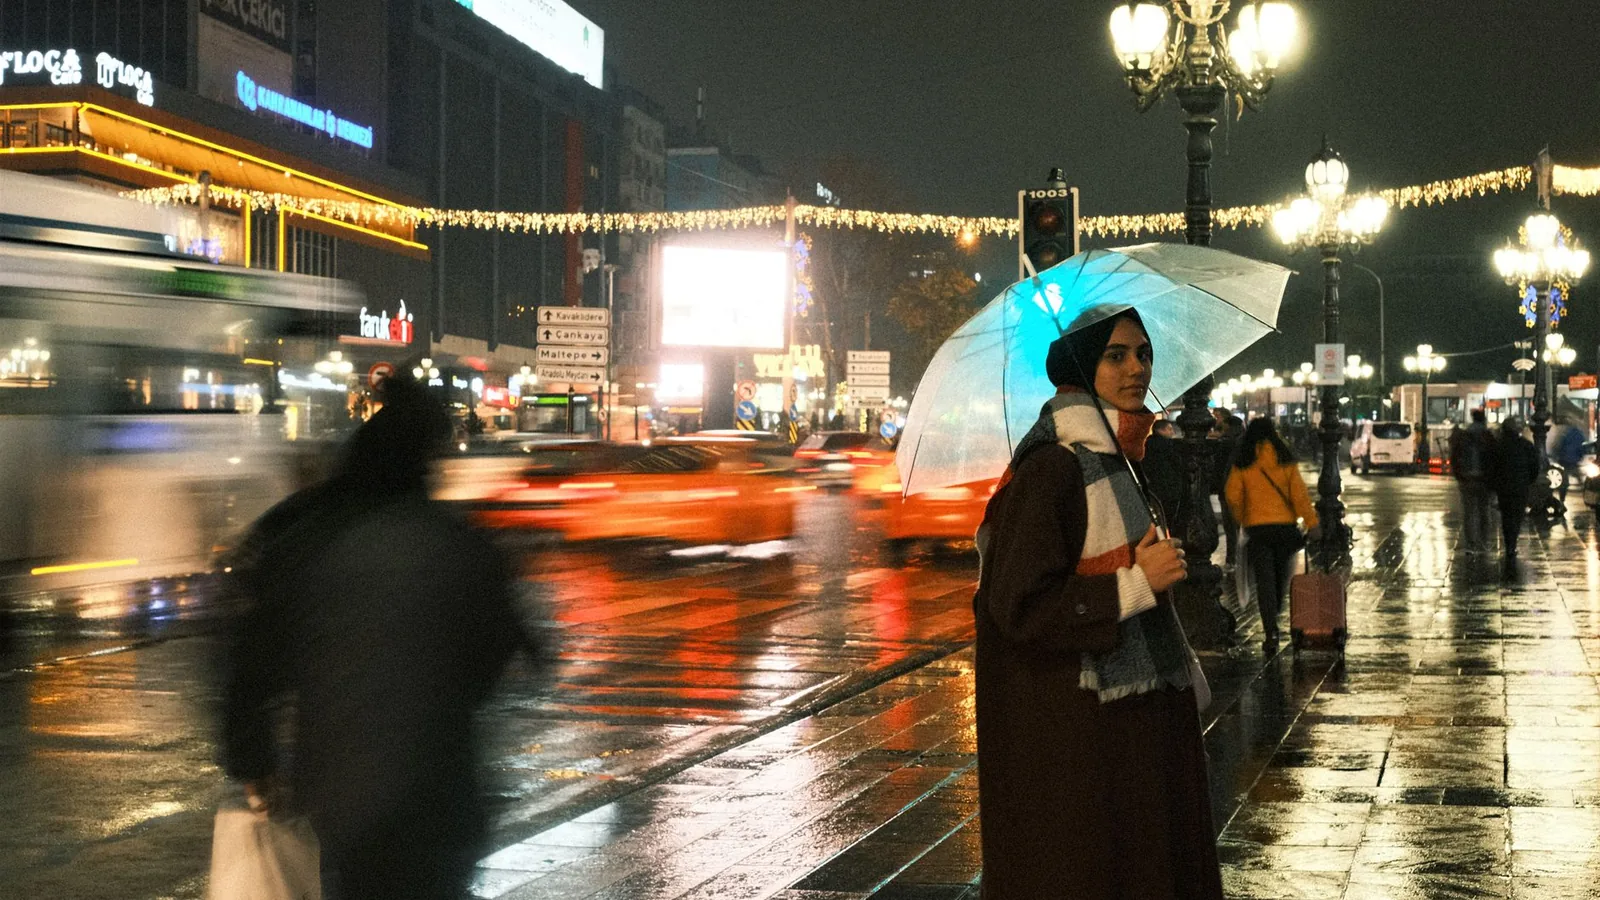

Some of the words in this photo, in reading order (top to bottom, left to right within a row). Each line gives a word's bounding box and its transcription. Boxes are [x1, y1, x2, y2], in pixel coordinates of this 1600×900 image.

[1029, 189, 1068, 198] 1003
[555, 330, 603, 341] Çankaya
[540, 350, 587, 360] Maltepe
